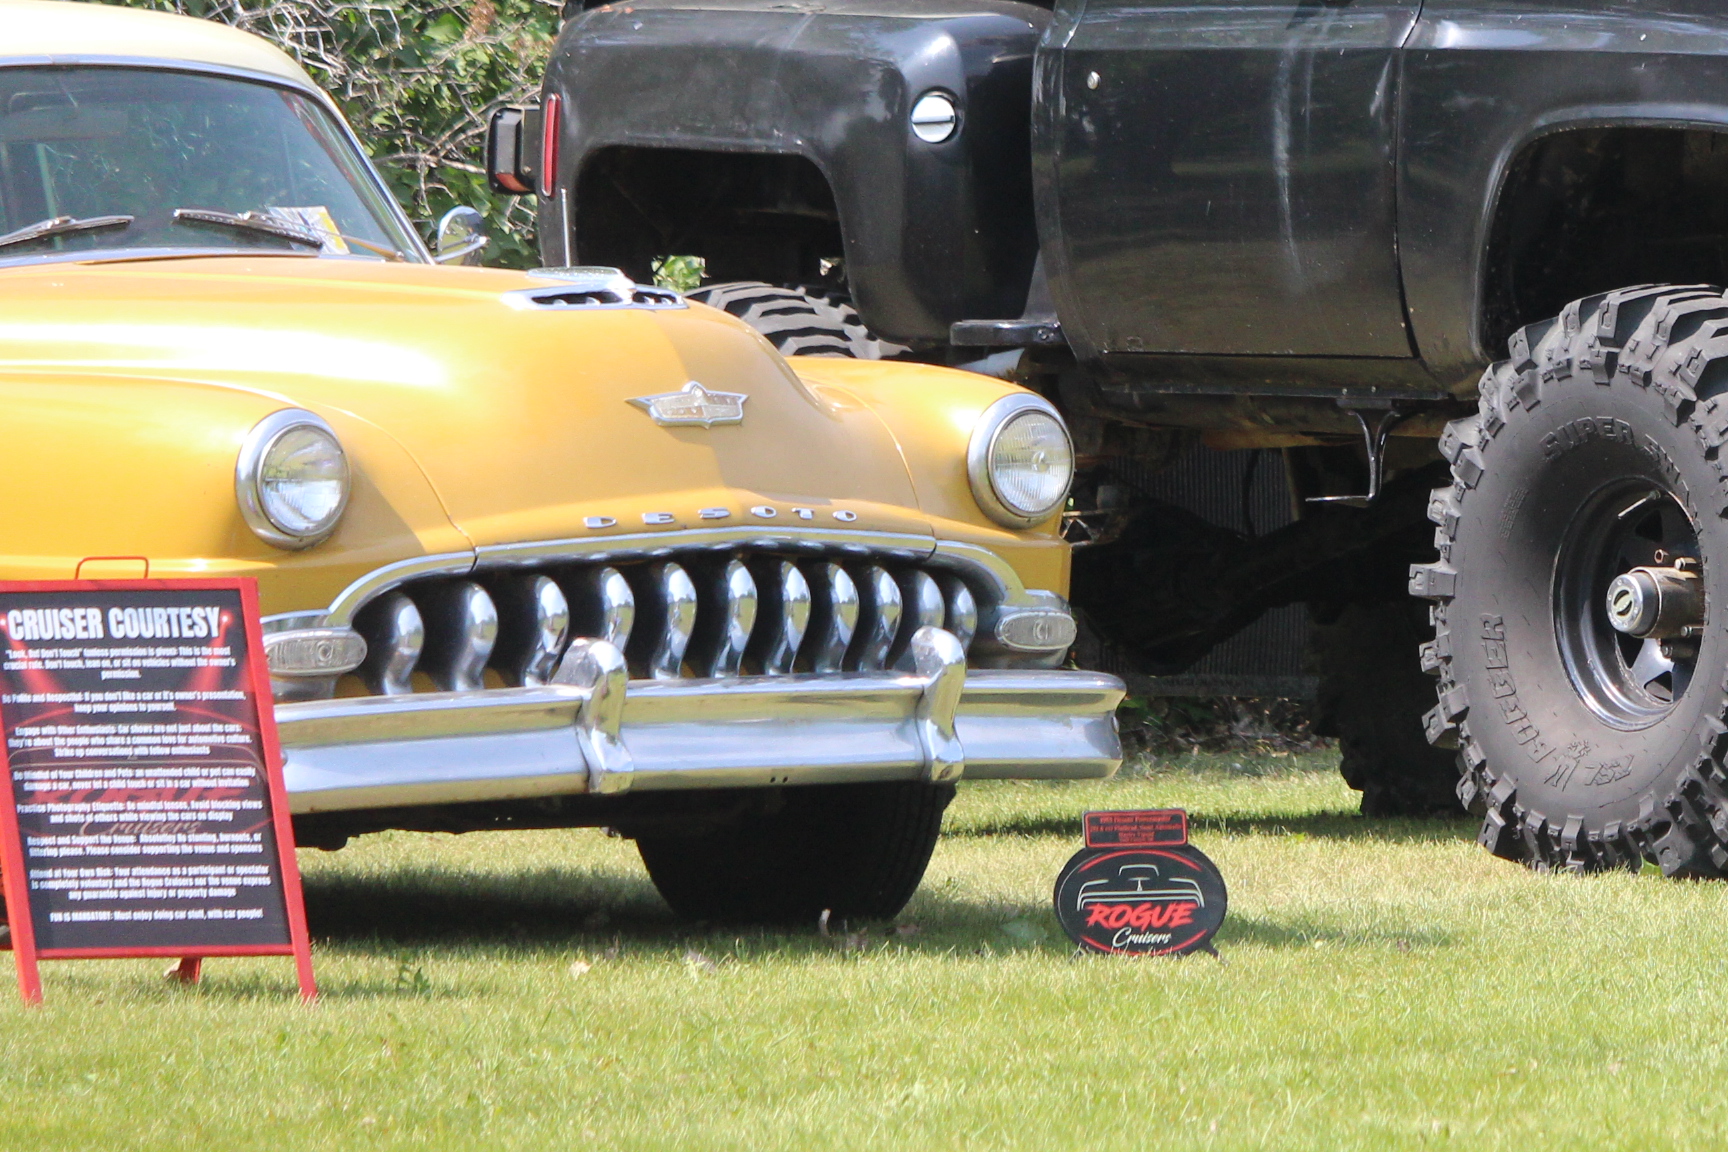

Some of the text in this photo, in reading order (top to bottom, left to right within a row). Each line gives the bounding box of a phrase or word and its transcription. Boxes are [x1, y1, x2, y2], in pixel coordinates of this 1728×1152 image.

[7, 607, 220, 641] CRUISER COURTESY
[1086, 901, 1198, 932] ROGUE
[1112, 926, 1172, 948] Cruisers
